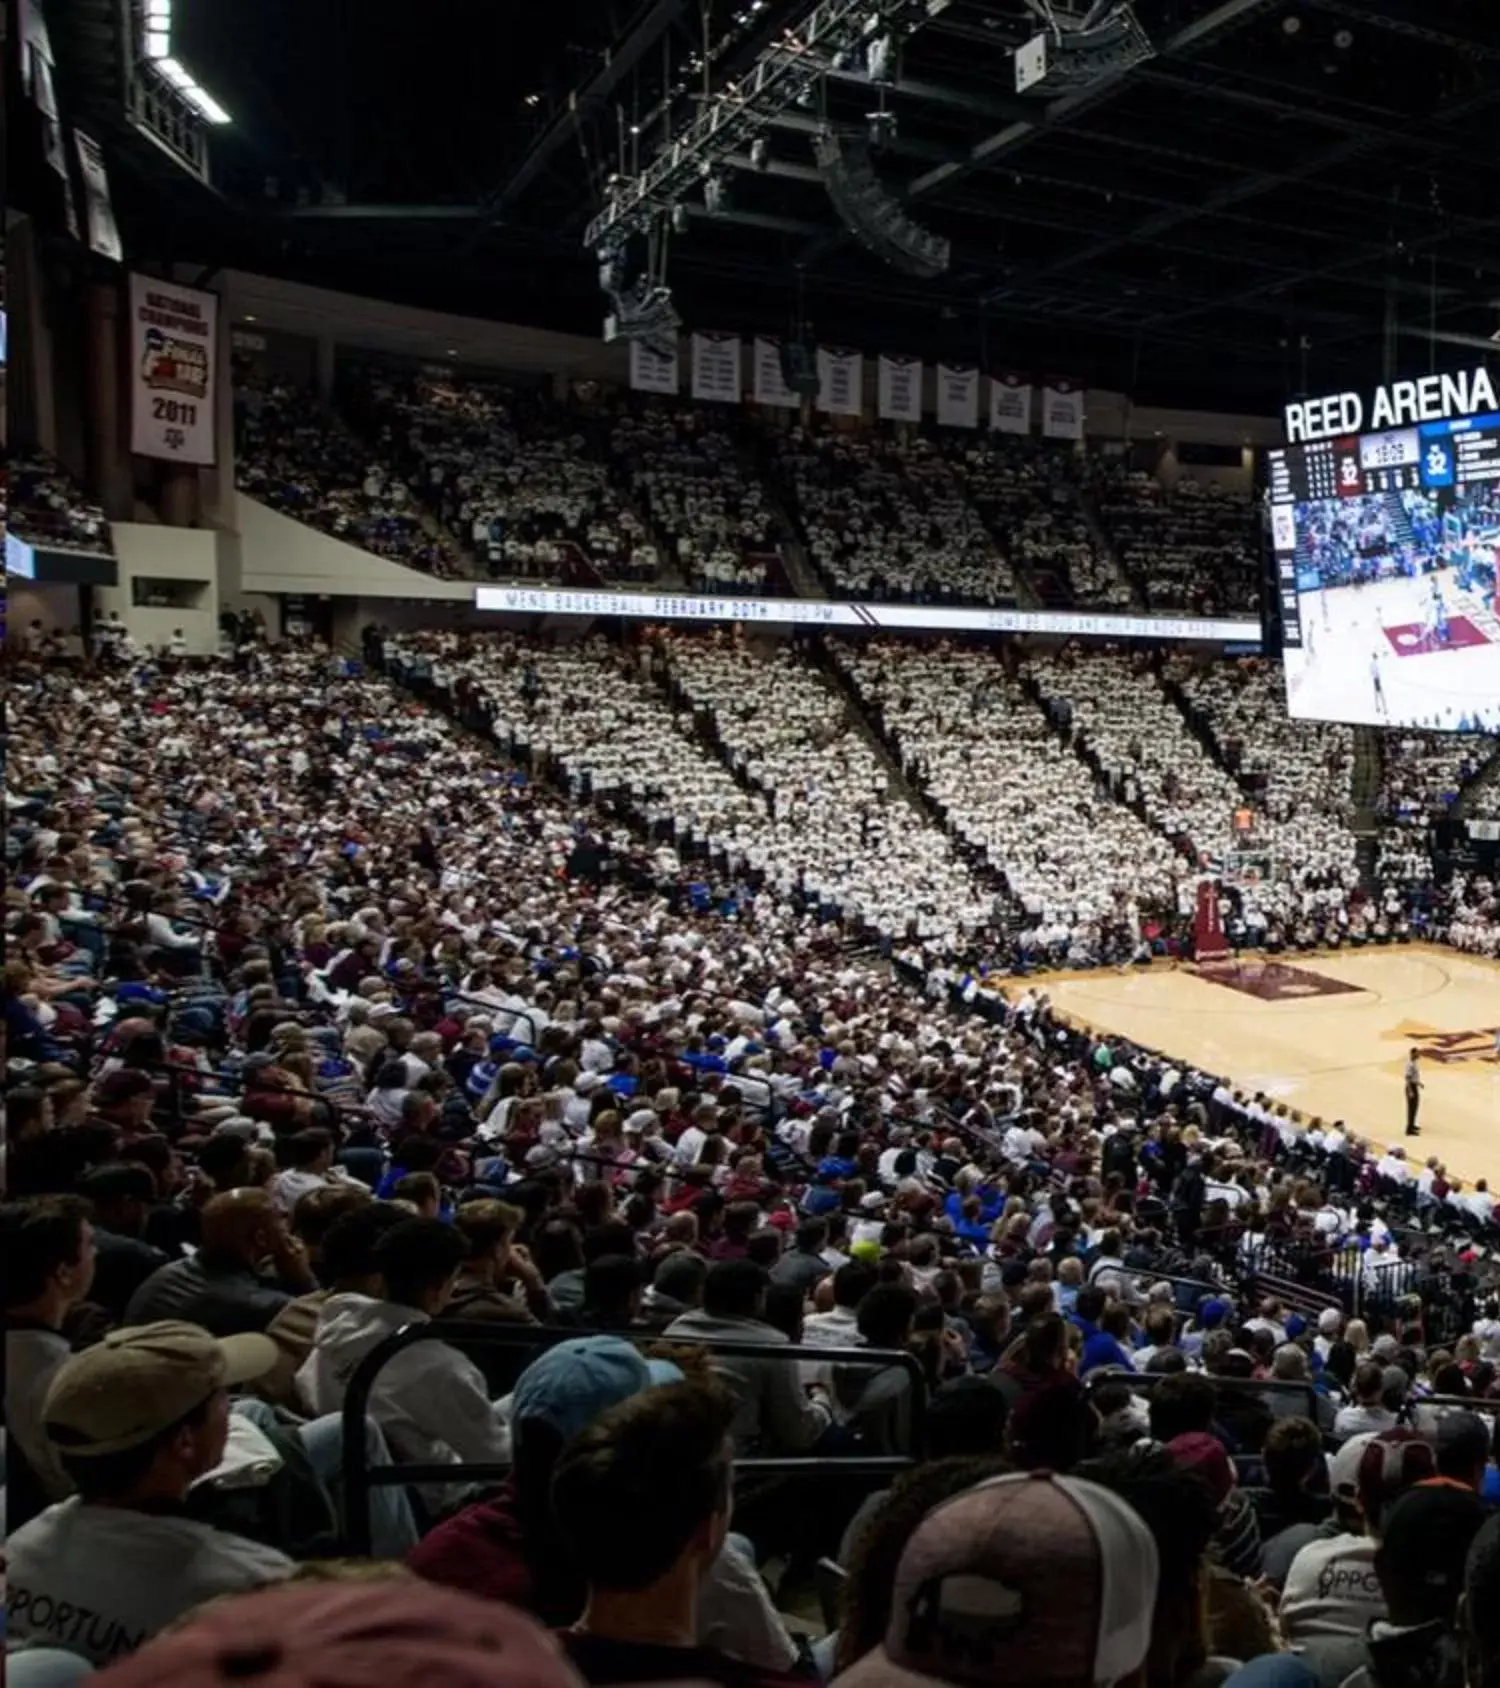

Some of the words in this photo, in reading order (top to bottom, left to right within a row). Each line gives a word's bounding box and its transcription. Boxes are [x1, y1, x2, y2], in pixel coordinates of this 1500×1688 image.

[152, 397, 197, 426] 2011
[1285, 392, 1364, 443] REED
[1371, 367, 1499, 429] ARENA
[655, 597, 725, 617] FEBRUARY
[732, 601, 768, 618] 20TH
[7, 1587, 148, 1658] PORTUN
